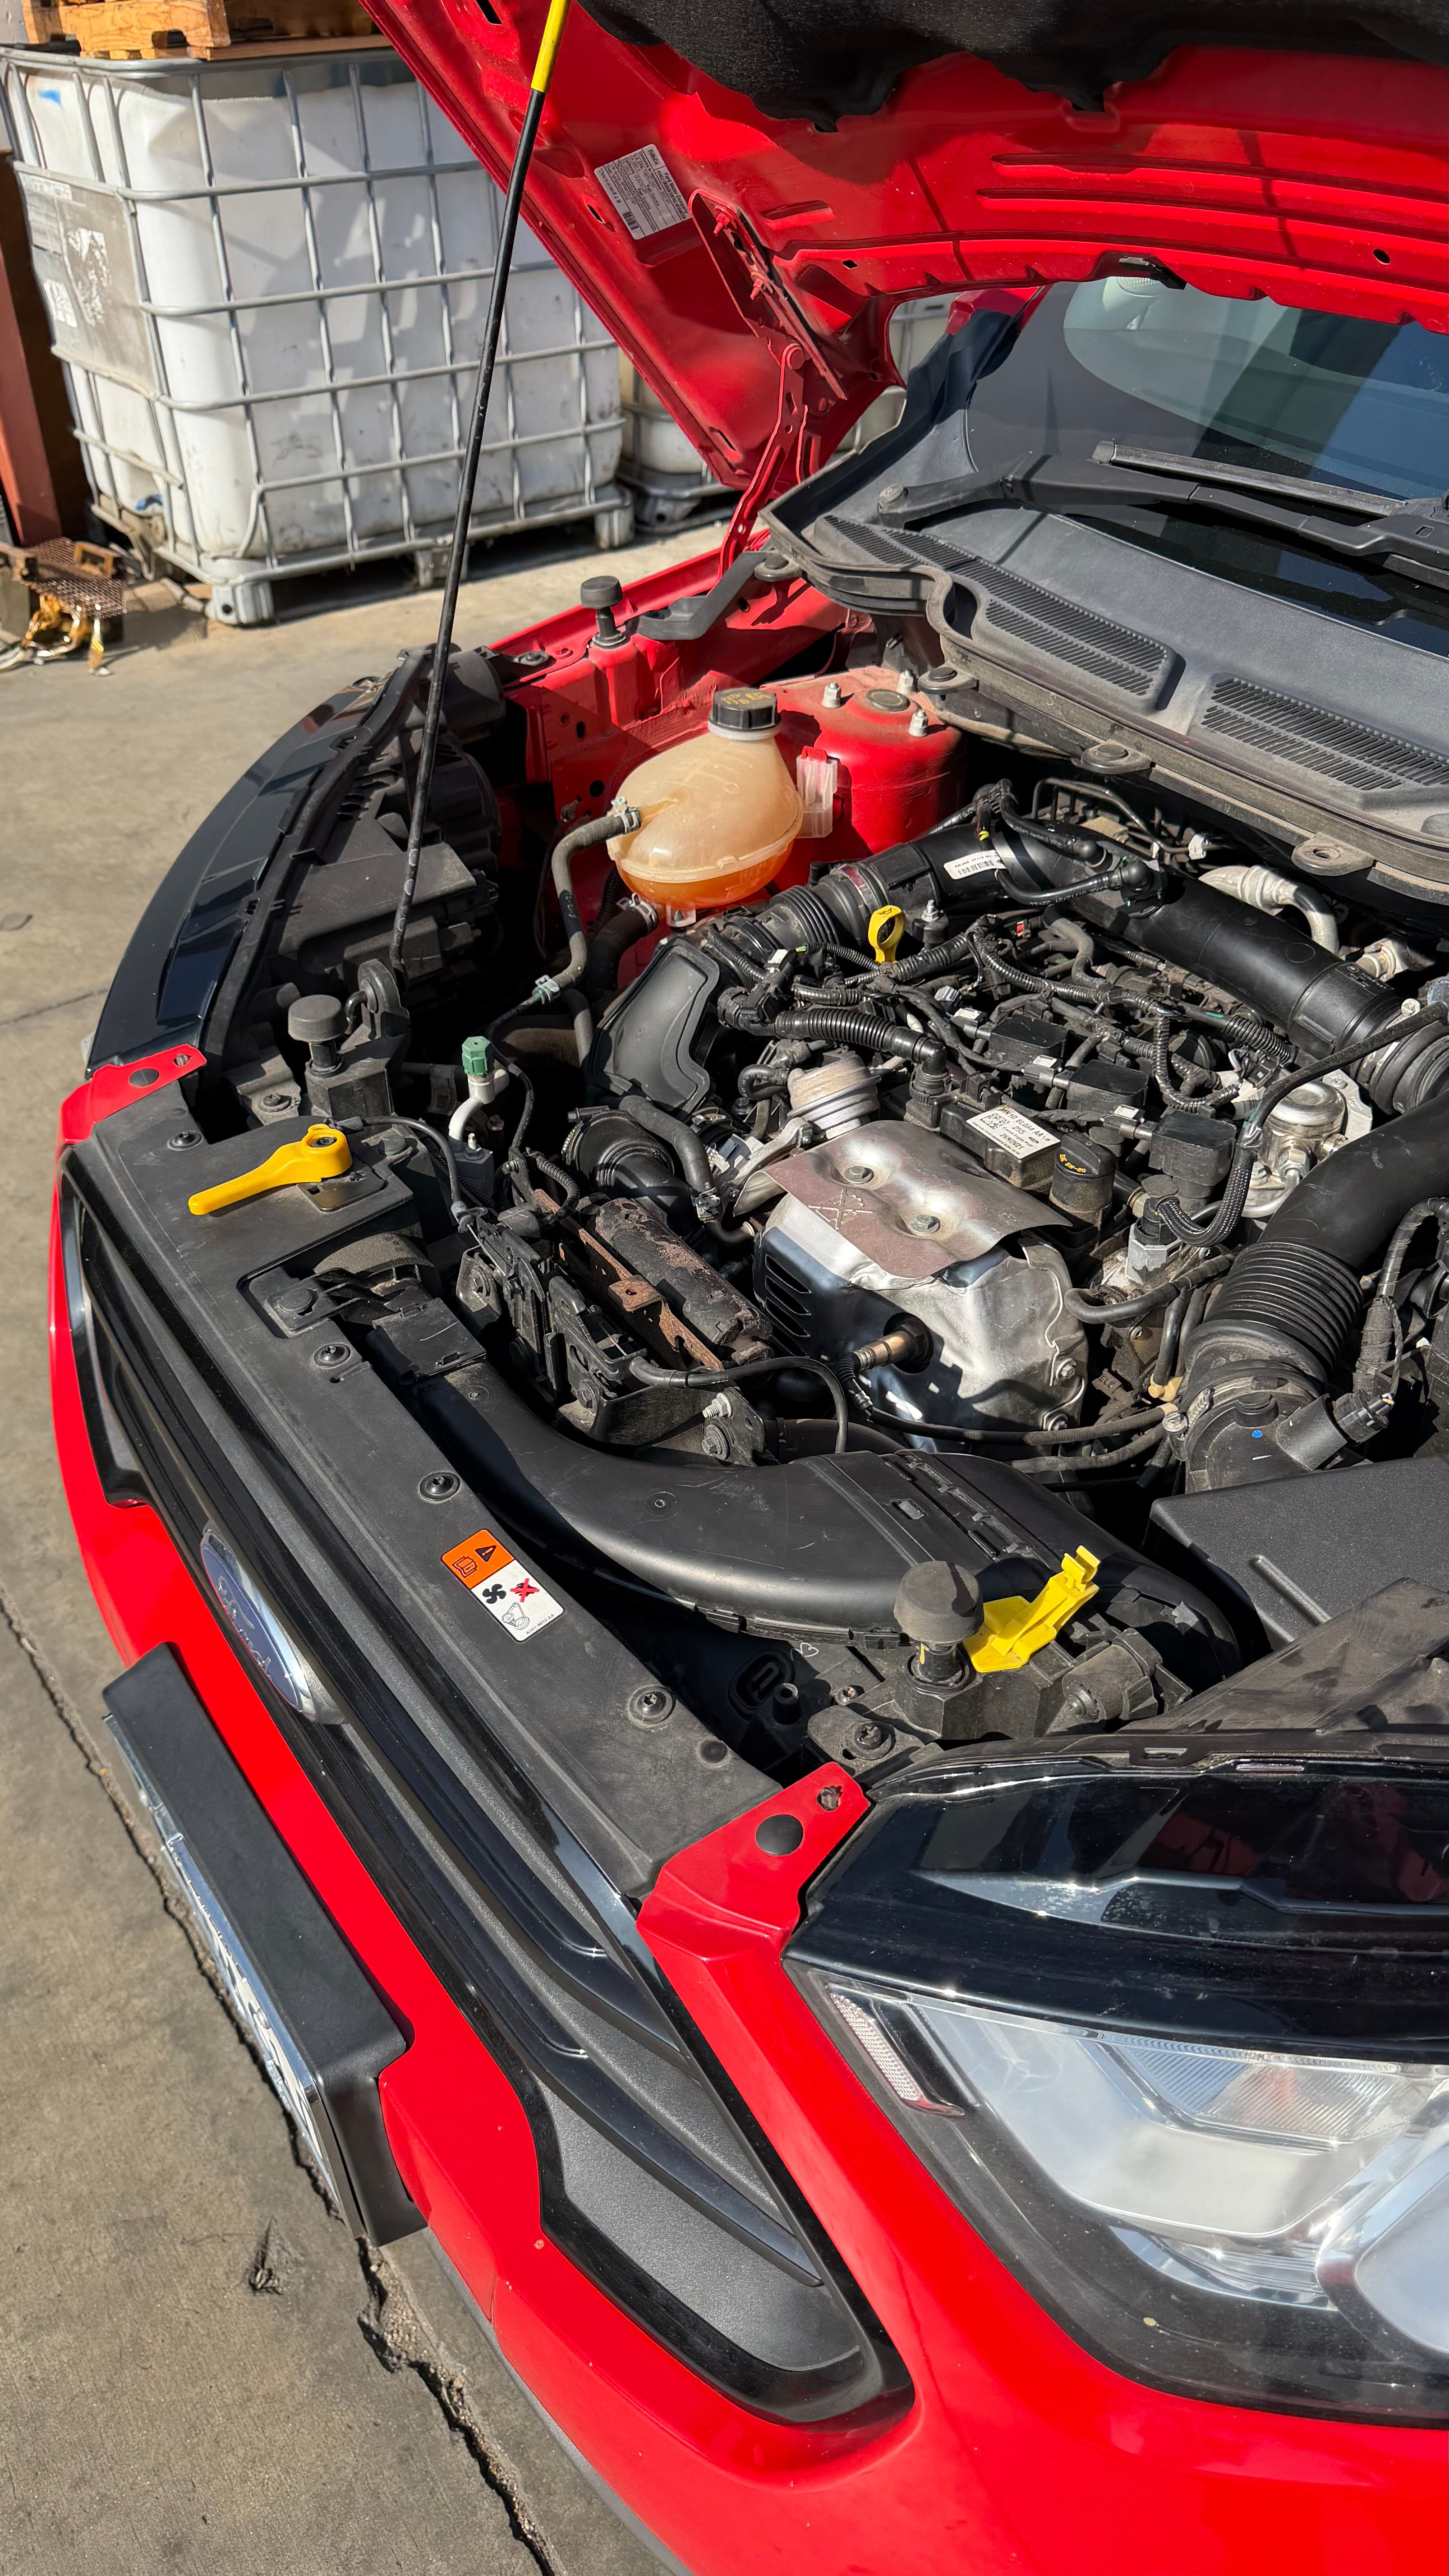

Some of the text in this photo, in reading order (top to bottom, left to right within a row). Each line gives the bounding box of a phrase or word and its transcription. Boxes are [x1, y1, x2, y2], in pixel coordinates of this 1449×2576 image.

[662, 172, 689, 214] Ford Motor Company
[1011, 1125, 1027, 1135] 255
[998, 1132, 1025, 1150] 26NOV21
